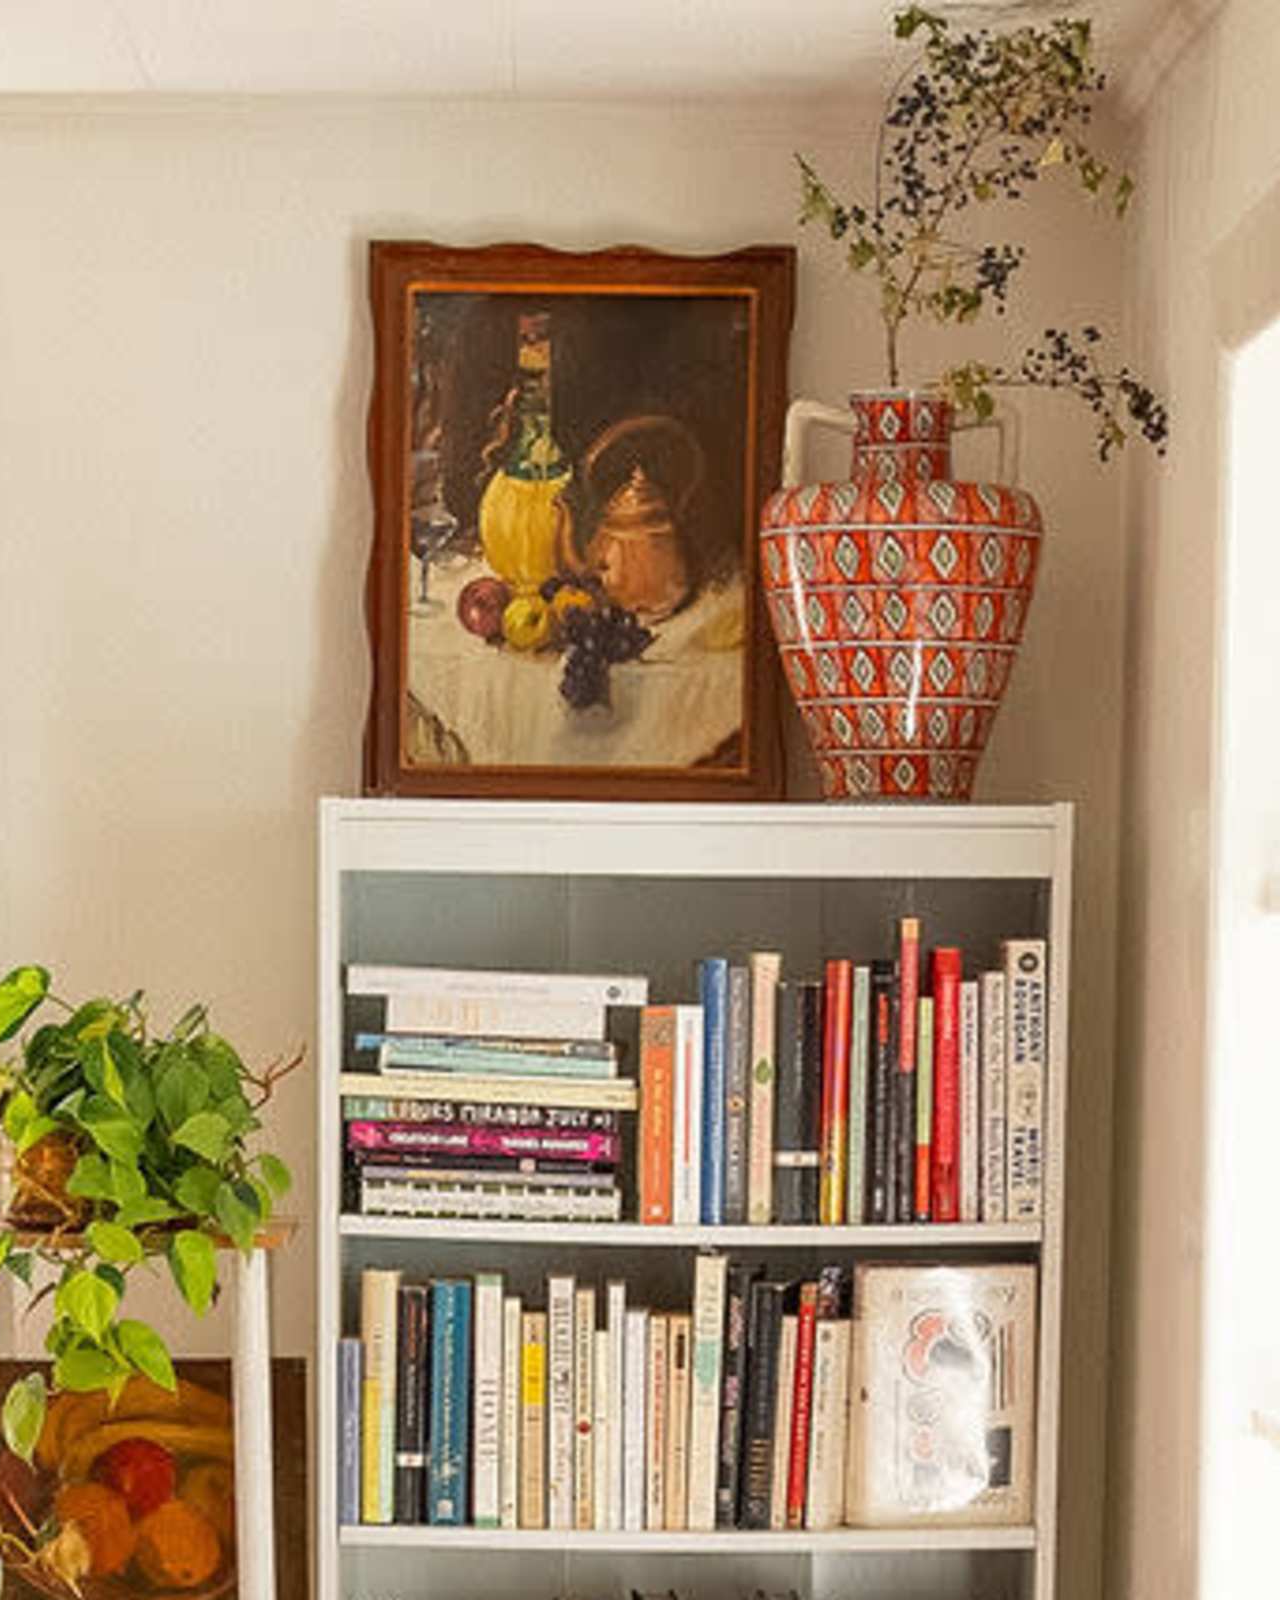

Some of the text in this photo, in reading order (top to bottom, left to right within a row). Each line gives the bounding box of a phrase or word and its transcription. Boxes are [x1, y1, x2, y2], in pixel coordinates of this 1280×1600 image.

[1014, 980, 1027, 1063] BOURDAIN
[1028, 981, 1041, 1062] ANTHONY
[460, 1104, 589, 1127] MIRANDA JULY
[1012, 1126, 1025, 1189] TRAVEL
[1026, 1128, 1039, 1187] WORLD
[479, 1379, 497, 1461] HOME
